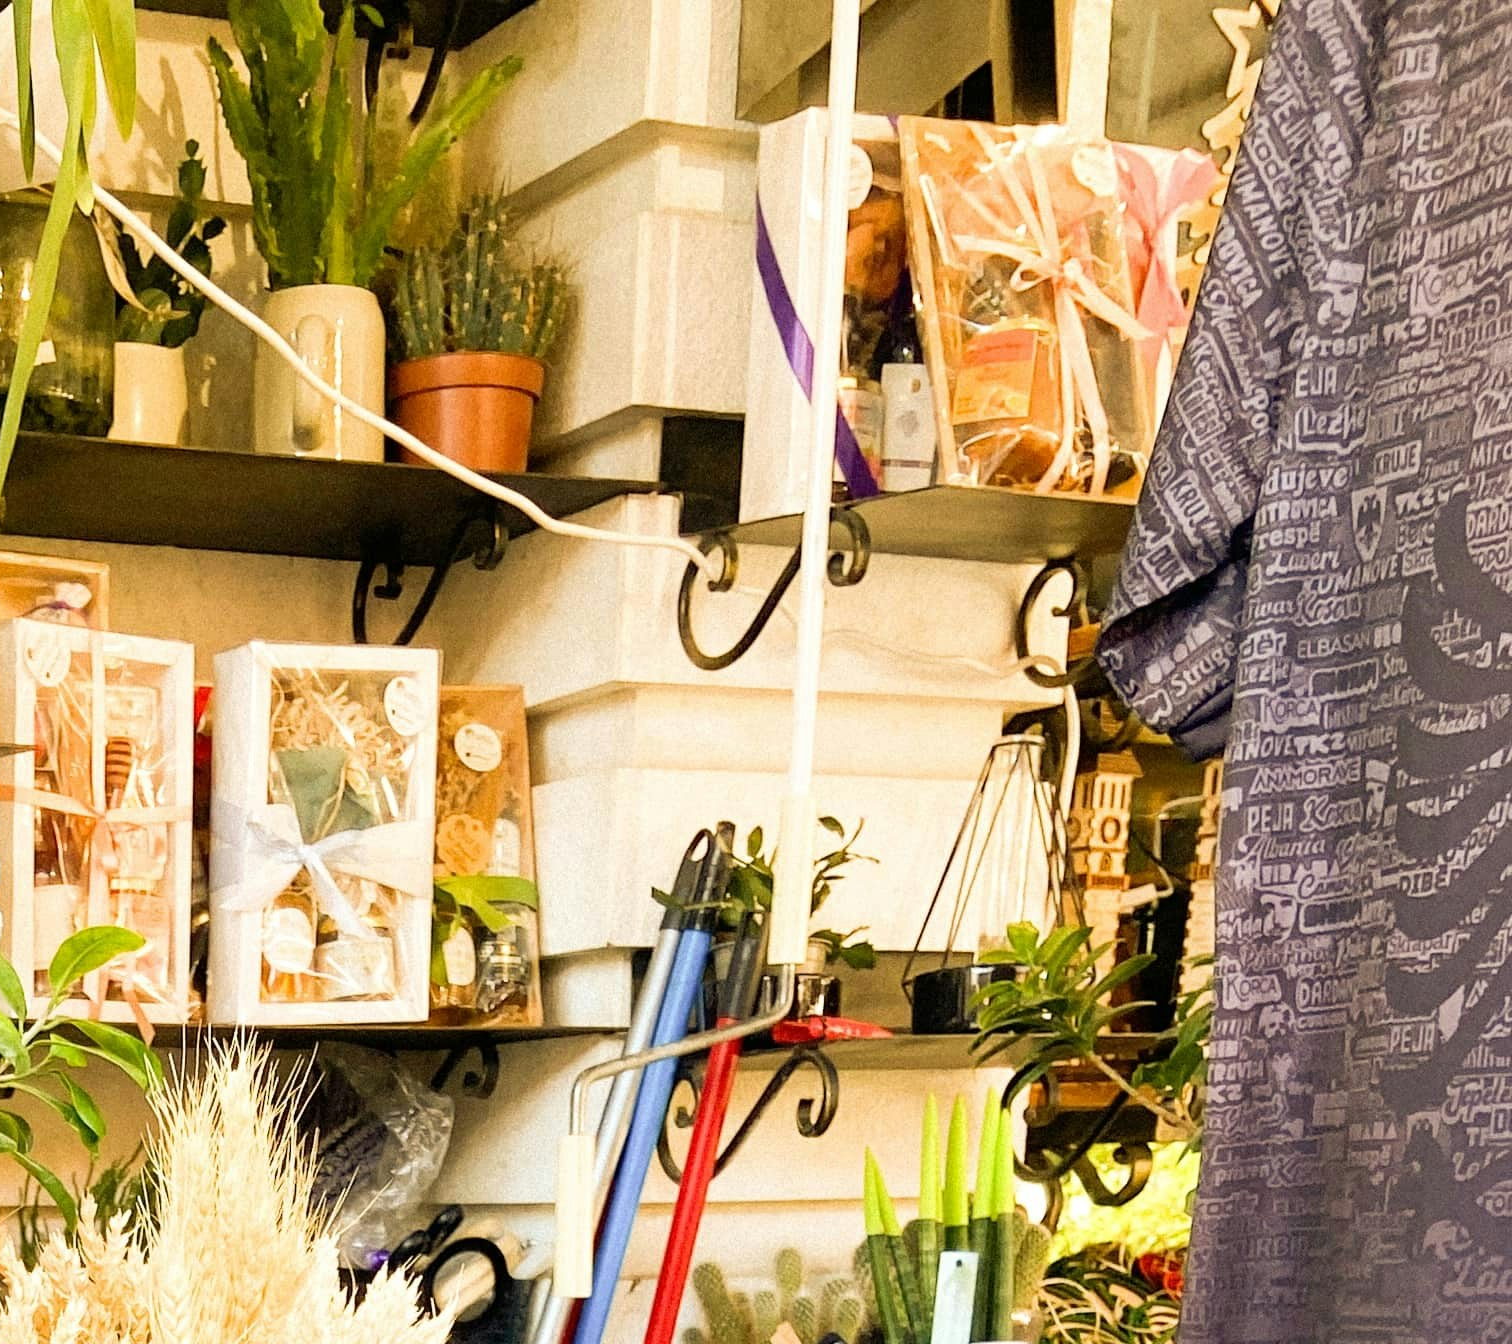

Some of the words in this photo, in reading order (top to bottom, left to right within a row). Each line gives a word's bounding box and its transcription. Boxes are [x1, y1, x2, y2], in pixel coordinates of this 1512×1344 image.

[1297, 630, 1371, 659] ELBASAN
[1247, 803, 1295, 834] PEJA
[1390, 1022, 1436, 1054] PEJA
